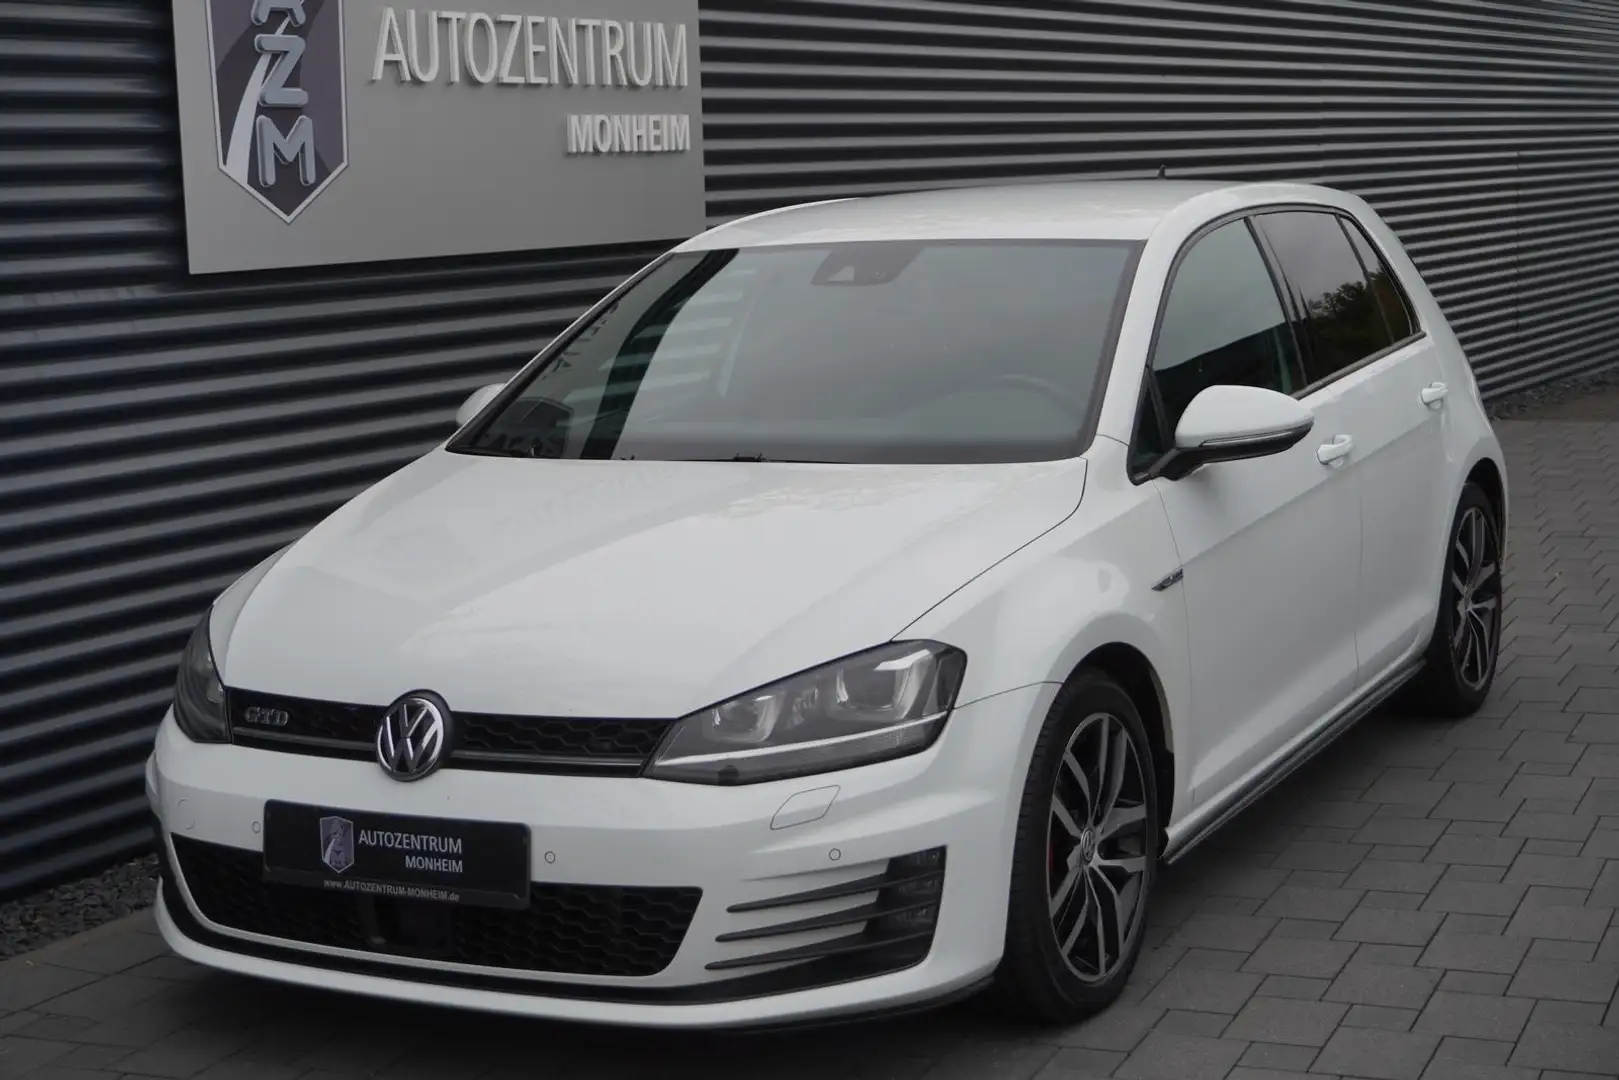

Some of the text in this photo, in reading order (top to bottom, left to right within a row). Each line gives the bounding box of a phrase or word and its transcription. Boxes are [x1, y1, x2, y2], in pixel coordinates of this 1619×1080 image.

[371, 7, 688, 87] AUTOZENTRUM
[566, 114, 692, 153] MONHEIM
[244, 705, 290, 727] GTD
[358, 829, 462, 855] AUTOZENTRUM
[405, 855, 463, 873] MONHEIM
[323, 879, 460, 902] www.AUTOZENTRUM-MONHEIM.de
